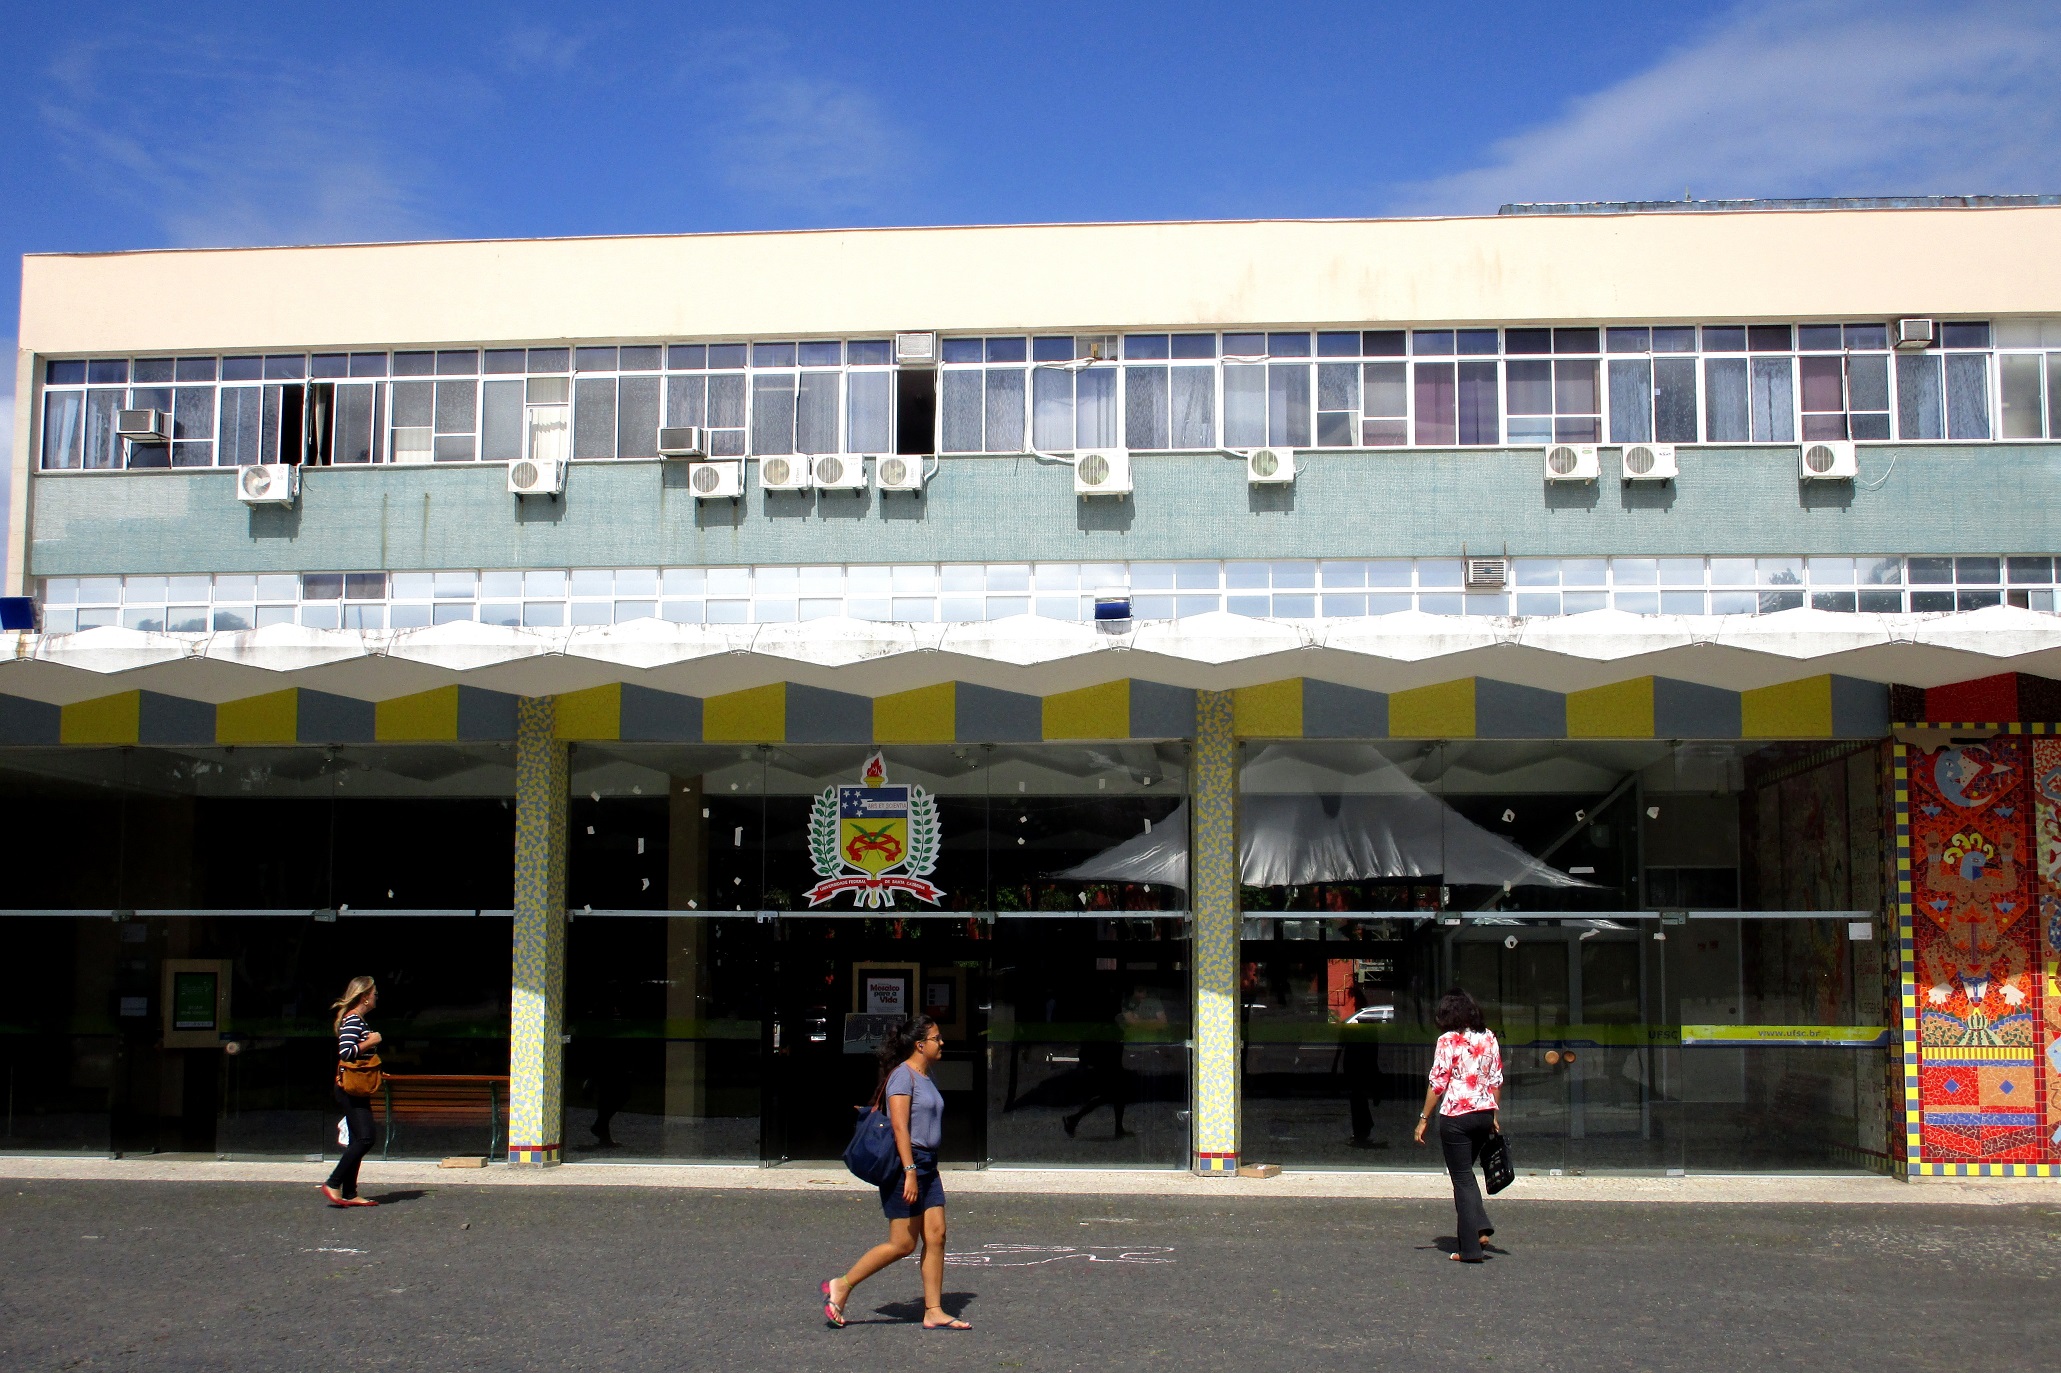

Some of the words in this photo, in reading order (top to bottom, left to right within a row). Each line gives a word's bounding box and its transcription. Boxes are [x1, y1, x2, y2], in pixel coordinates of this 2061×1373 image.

[819, 880, 848, 891] UNIVERSIDADE
[906, 881, 926, 890] CATARINA
[1648, 1030, 1678, 1039] UFSC
[1758, 1029, 1820, 1037] www.ufsc.br
